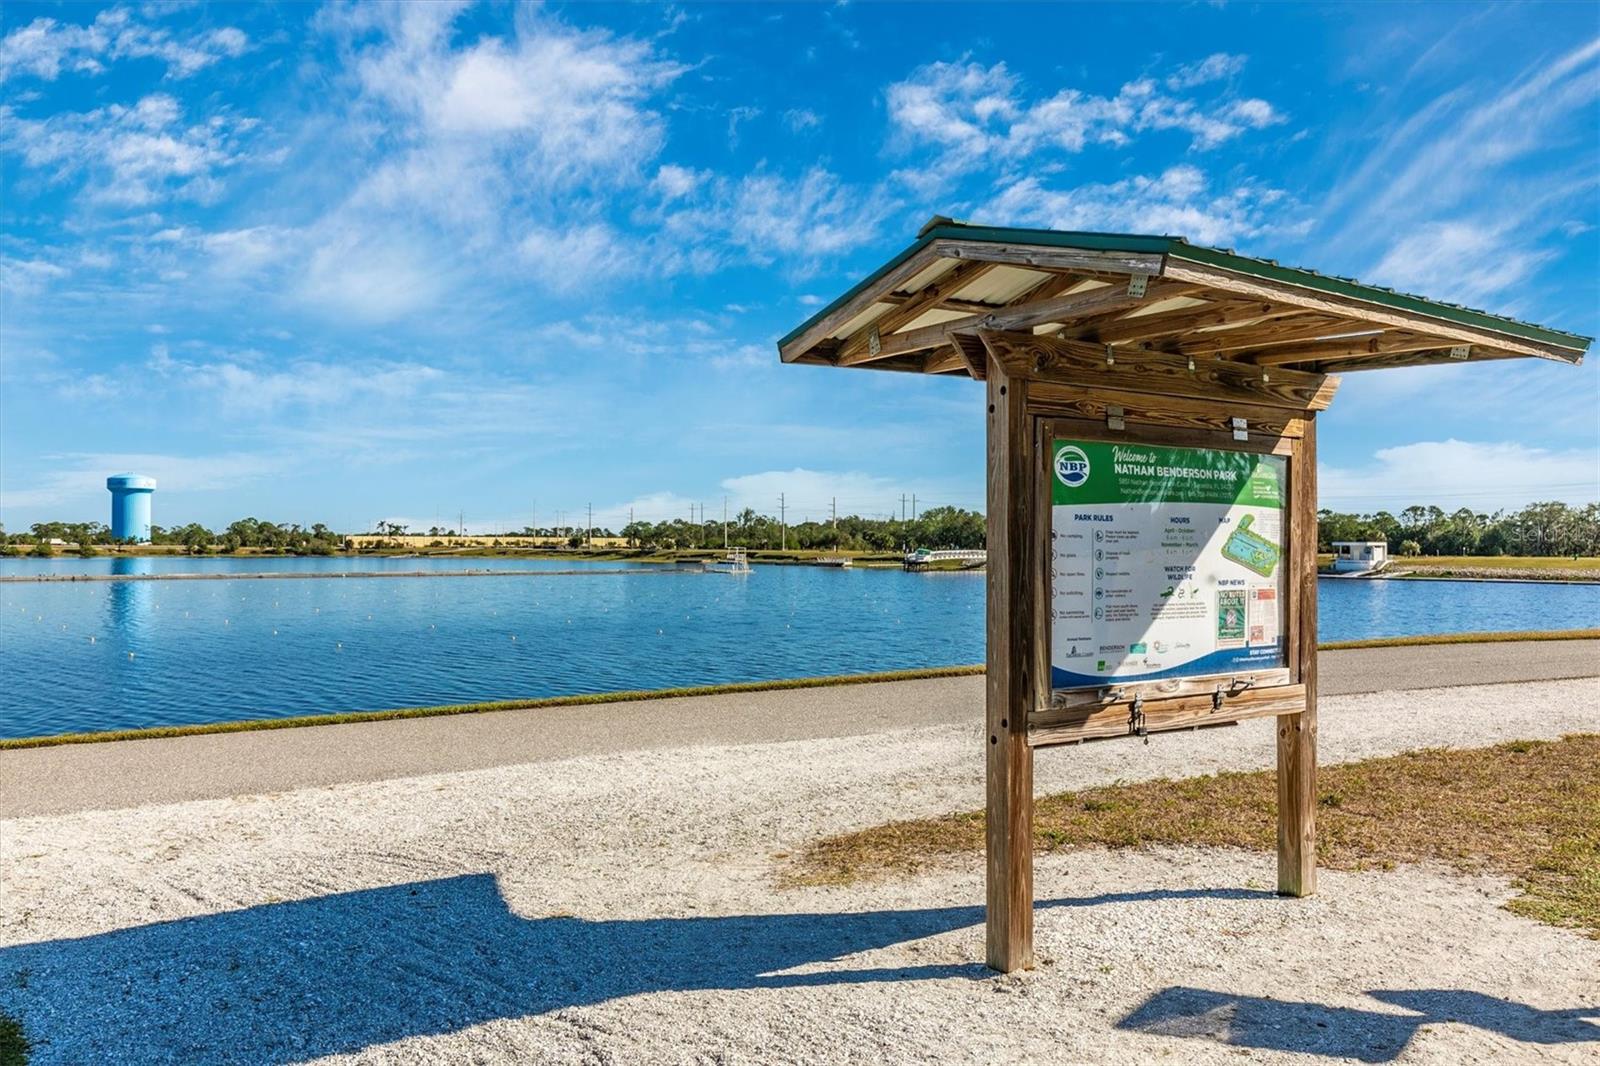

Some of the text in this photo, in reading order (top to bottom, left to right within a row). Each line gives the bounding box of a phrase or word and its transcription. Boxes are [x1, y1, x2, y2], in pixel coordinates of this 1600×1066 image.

[1112, 445, 1157, 464] Welcome to
[1060, 462, 1087, 471] NBP
[1114, 463, 1155, 476] NATHAN
[1157, 466, 1212, 479] BENDERSON
[1213, 470, 1237, 480] PARK
[1093, 514, 1113, 522] RULES
